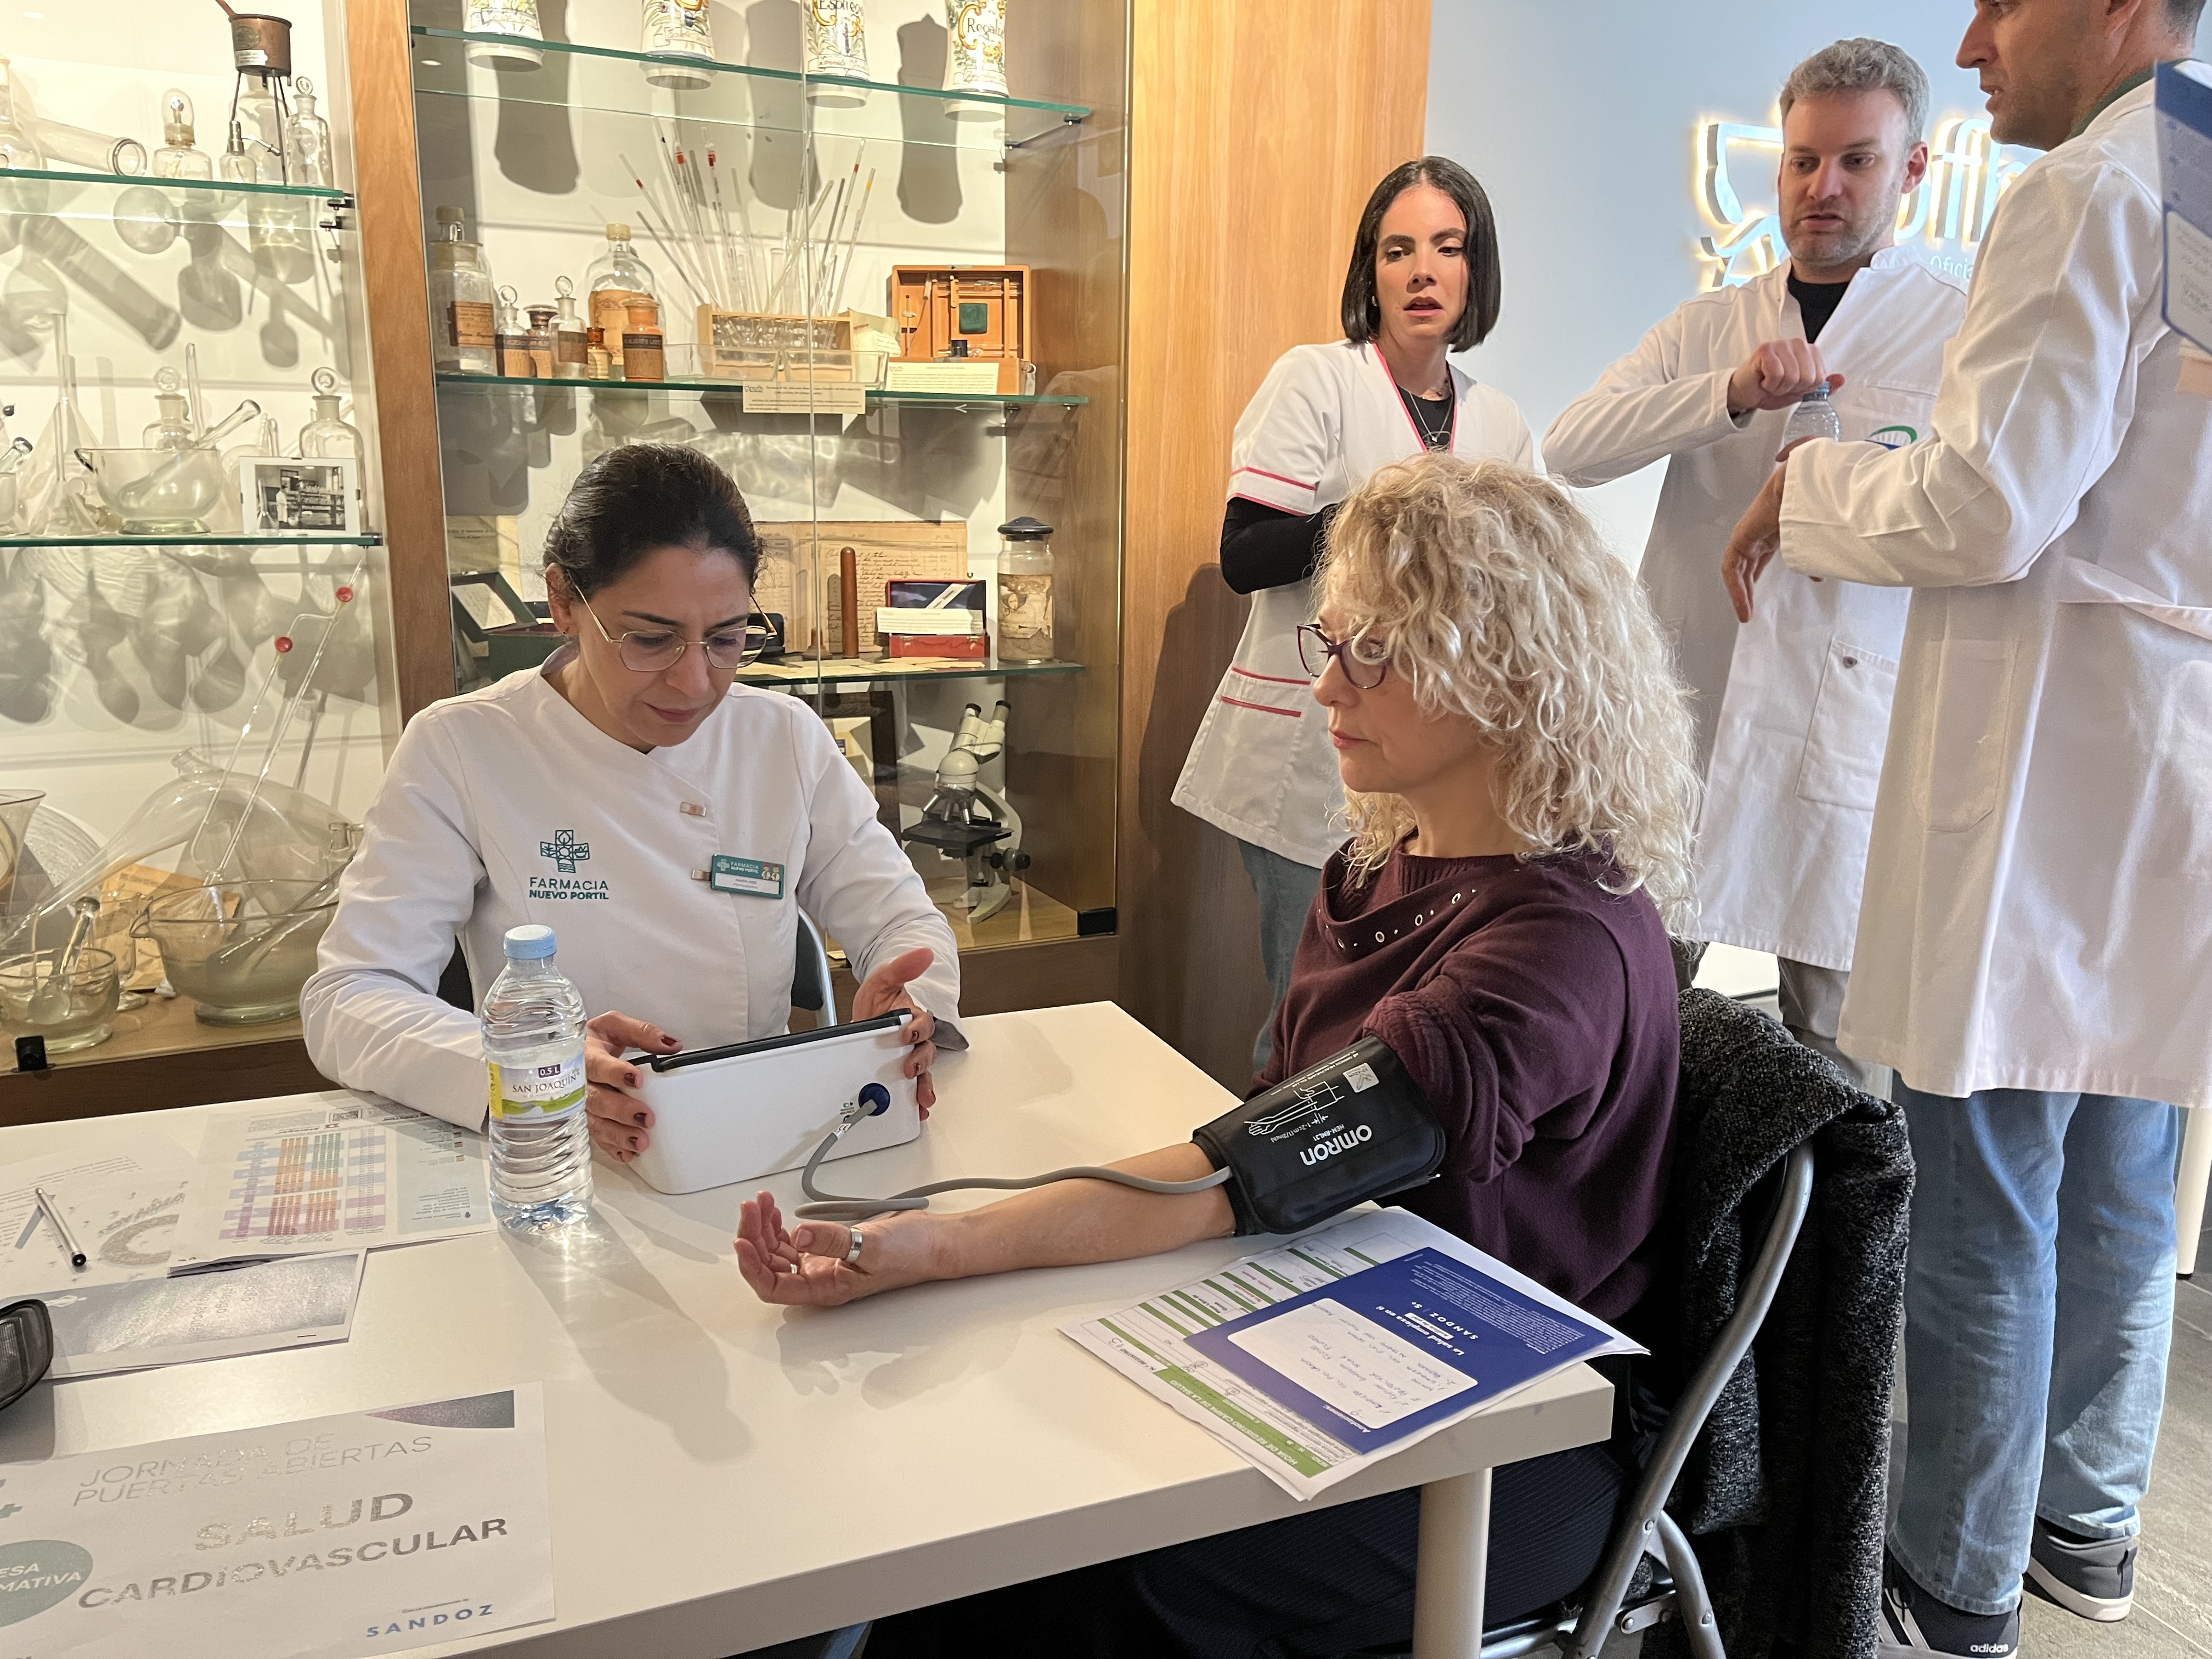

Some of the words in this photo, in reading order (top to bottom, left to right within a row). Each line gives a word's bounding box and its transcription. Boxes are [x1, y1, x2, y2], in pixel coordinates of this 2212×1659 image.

[730, 861, 759, 870] FARMACIA
[529, 877, 609, 890] FARMACIA
[529, 889, 567, 900] NUEVO
[570, 889, 609, 900] PORTIL
[512, 1084, 532, 1093] SAN
[535, 1074, 577, 1093] JOAQUÍN
[1393, 1316, 1432, 1335] empieza
[1427, 1313, 1480, 1339] SANDOZ
[1427, 1335, 1454, 1348] salud
[1451, 1347, 1465, 1356] La
[1169, 1380, 1194, 1395] SALUD
[1199, 1399, 1211, 1407] DE
[1231, 1421, 1268, 1444] REGISTRO
[80, 1446, 269, 1488] JORNADA
[285, 1432, 335, 1455] DE
[1276, 1451, 1298, 1464] HOJA
[72, 1460, 245, 1508] PUERTAS
[257, 1435, 433, 1482] ABIERTAS
[194, 1492, 414, 1551] SALUD
[0, 1563, 40, 1578] ESA
[78, 1517, 509, 1611] CARDIOVASCULAR
[0, 1571, 81, 1592] MATIVA
[366, 1602, 494, 1638] SANDOZ
[1970, 1643, 2009, 1654] adidas
